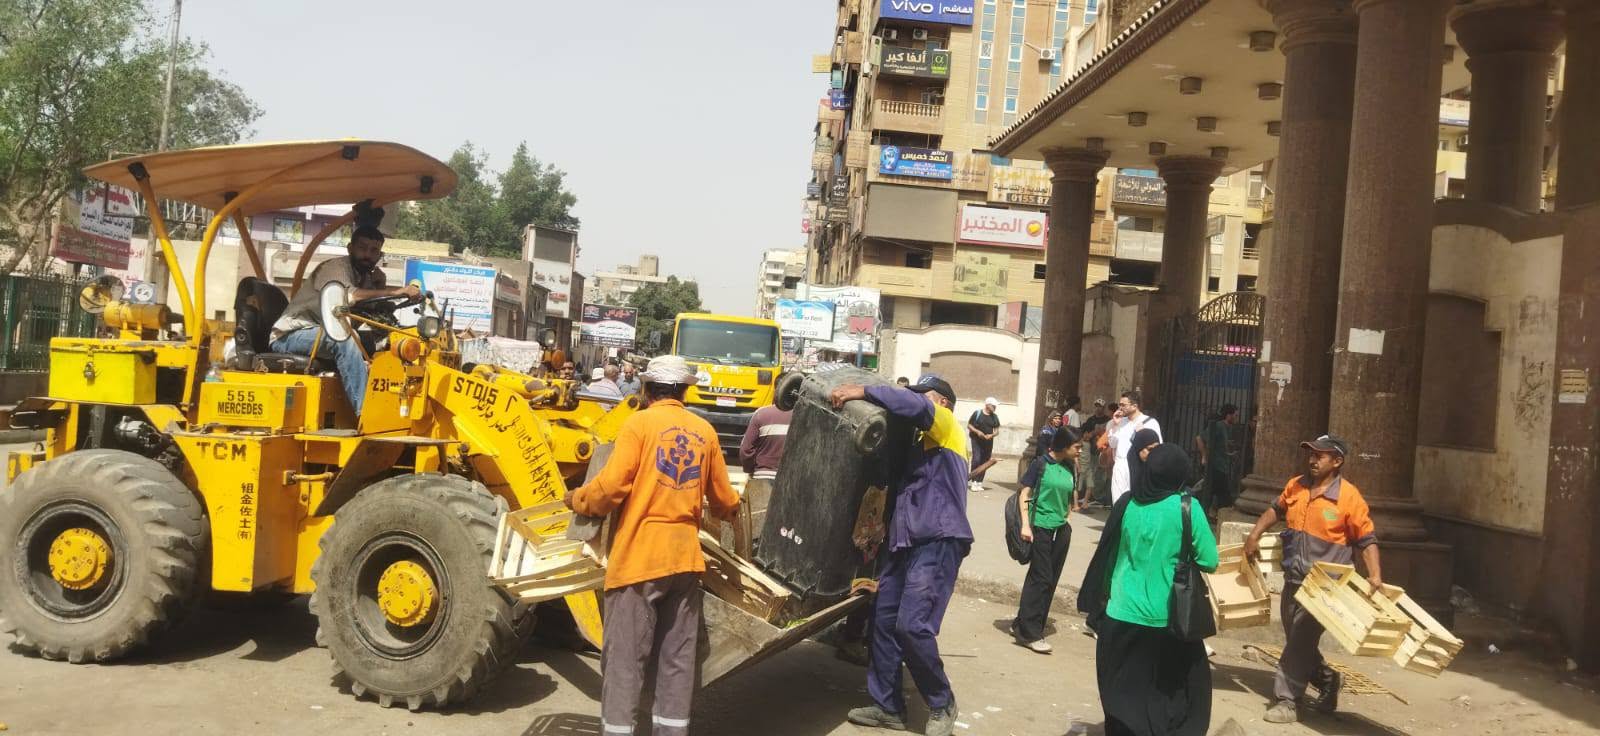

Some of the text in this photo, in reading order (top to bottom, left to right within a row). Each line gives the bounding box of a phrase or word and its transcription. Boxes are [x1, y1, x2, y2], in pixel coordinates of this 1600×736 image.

[892, 0, 934, 13] vivo
[885, 50, 928, 64] ألفا كير
[963, 216, 1022, 233] المختبر
[708, 386, 744, 395] IVECO
[217, 402, 263, 415] MERCEDES
[196, 441, 247, 461] TCM
